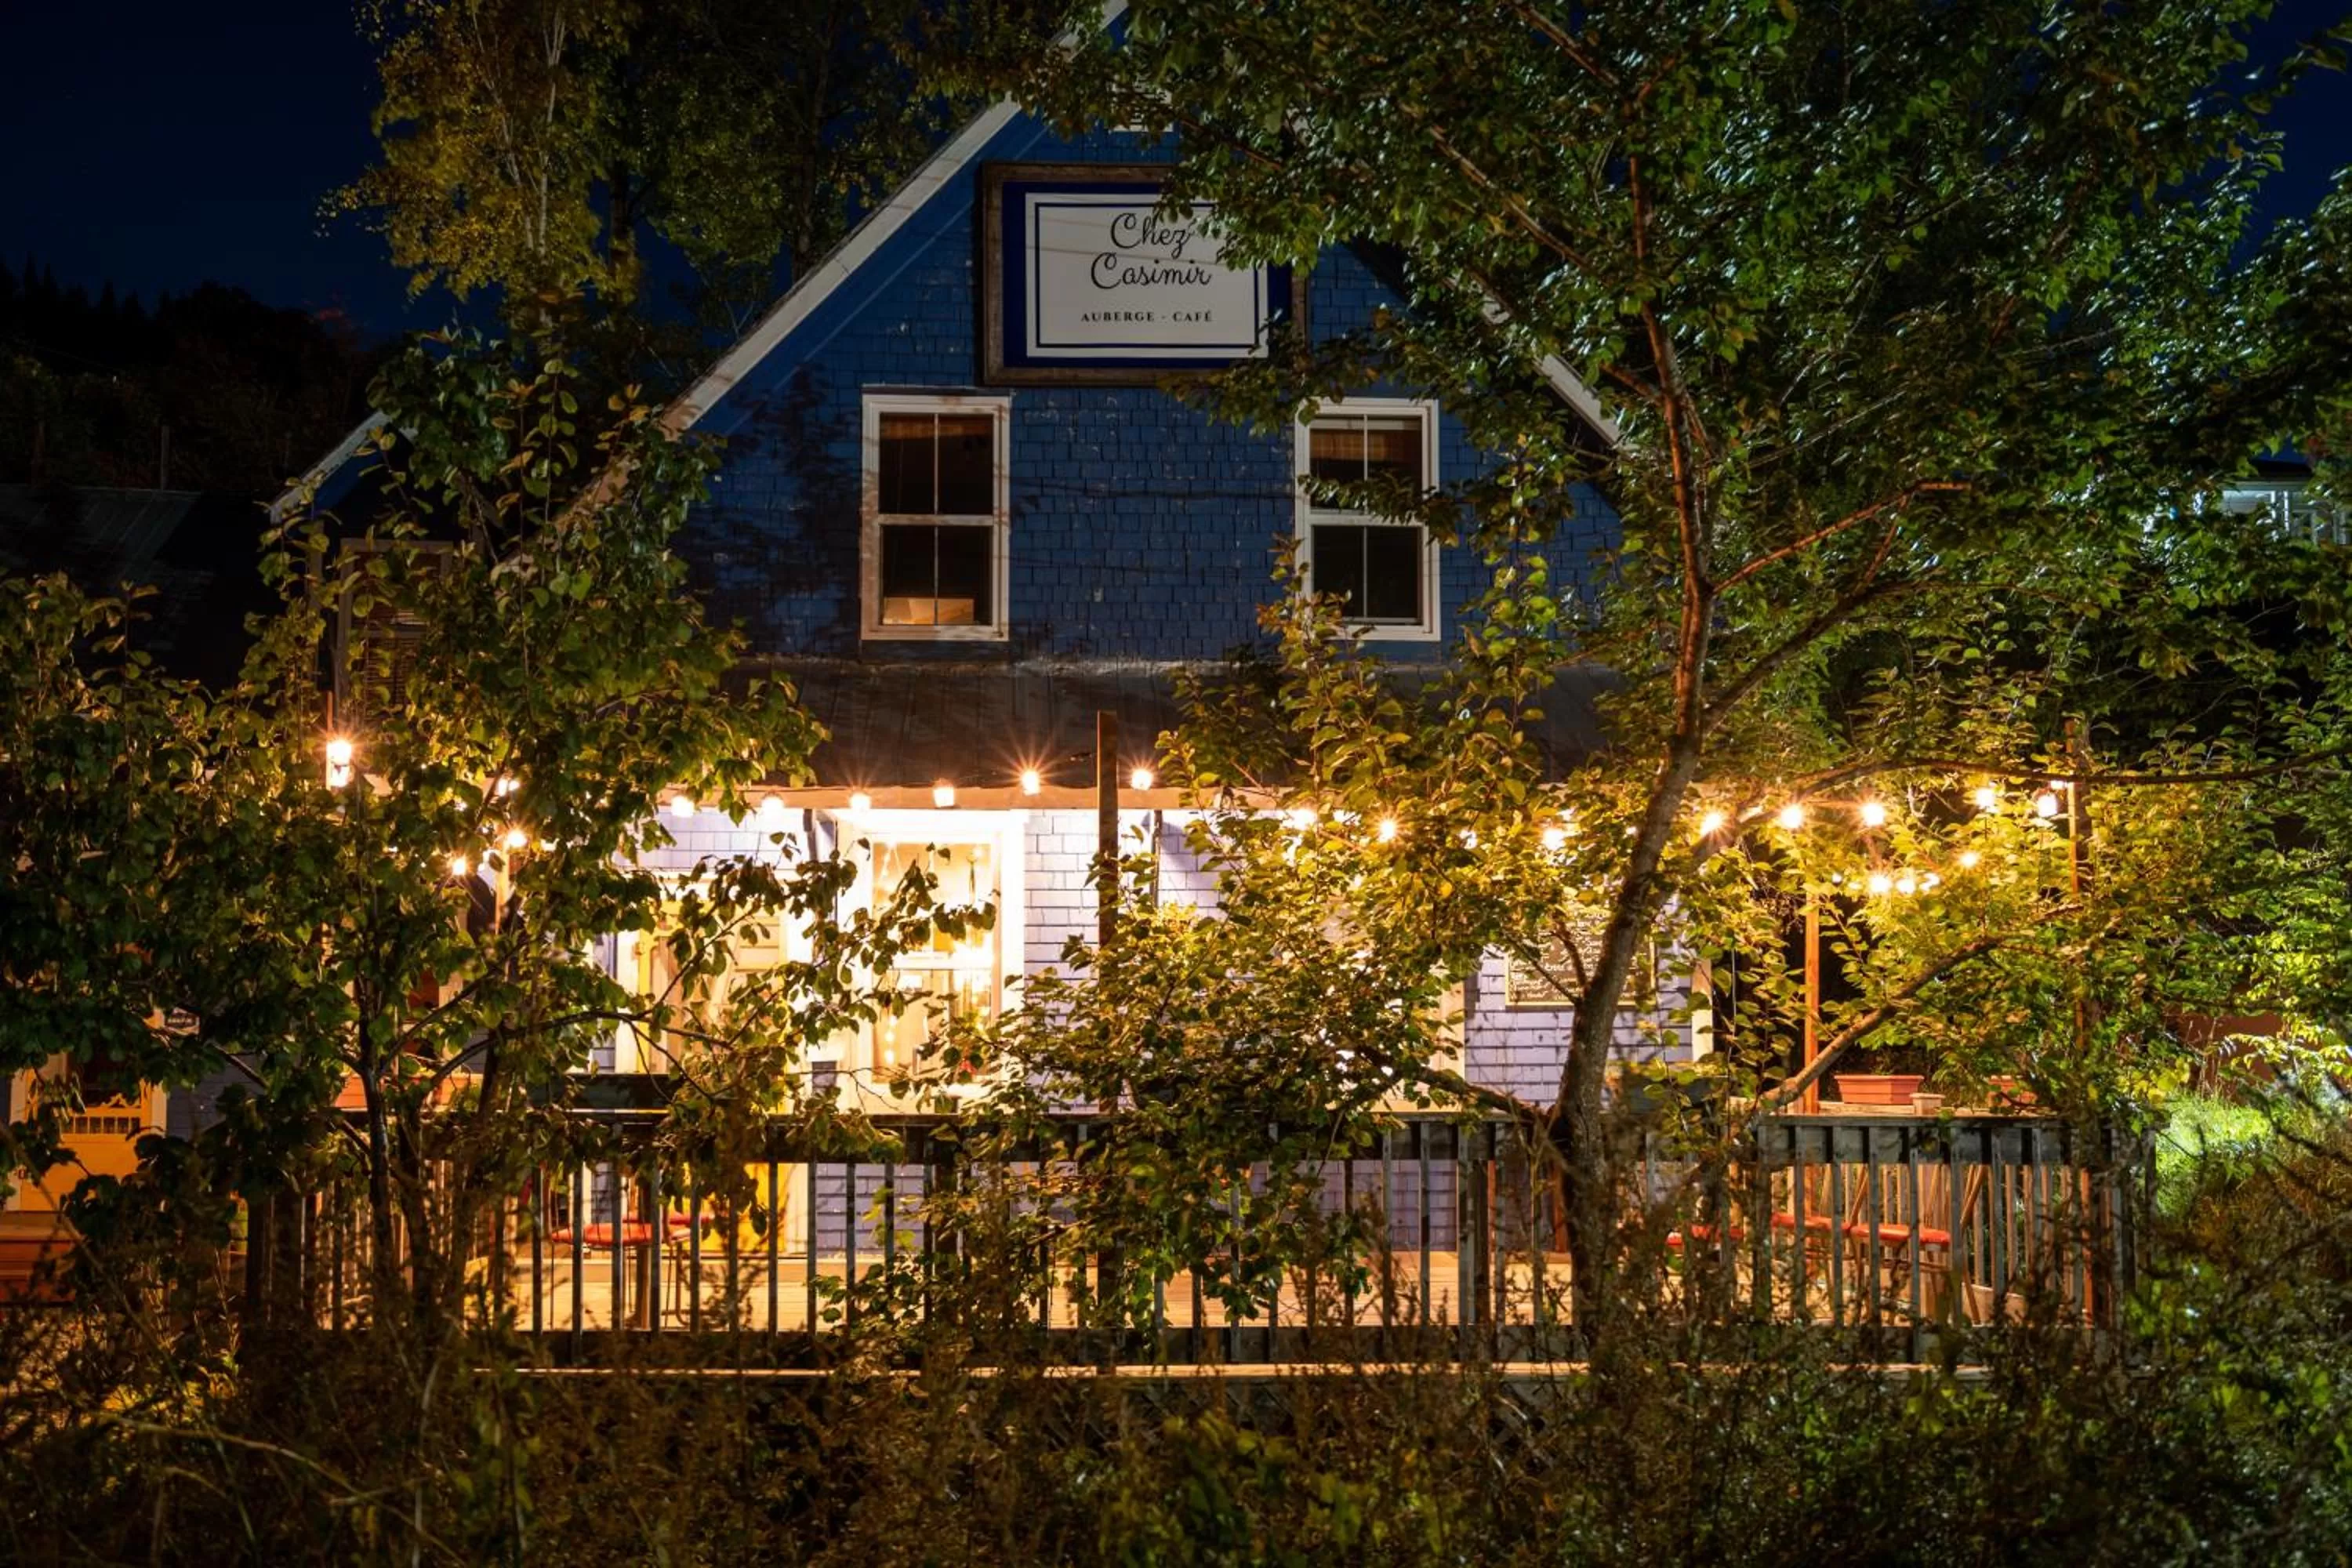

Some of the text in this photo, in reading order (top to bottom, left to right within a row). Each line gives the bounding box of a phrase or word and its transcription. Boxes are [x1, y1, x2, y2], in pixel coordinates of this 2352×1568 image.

[1110, 212, 1193, 260] Chez
[1091, 252, 1212, 289] Casimir
[1080, 311, 1154, 322] AUBERGE
[1173, 310, 1212, 322] CAFÉ
